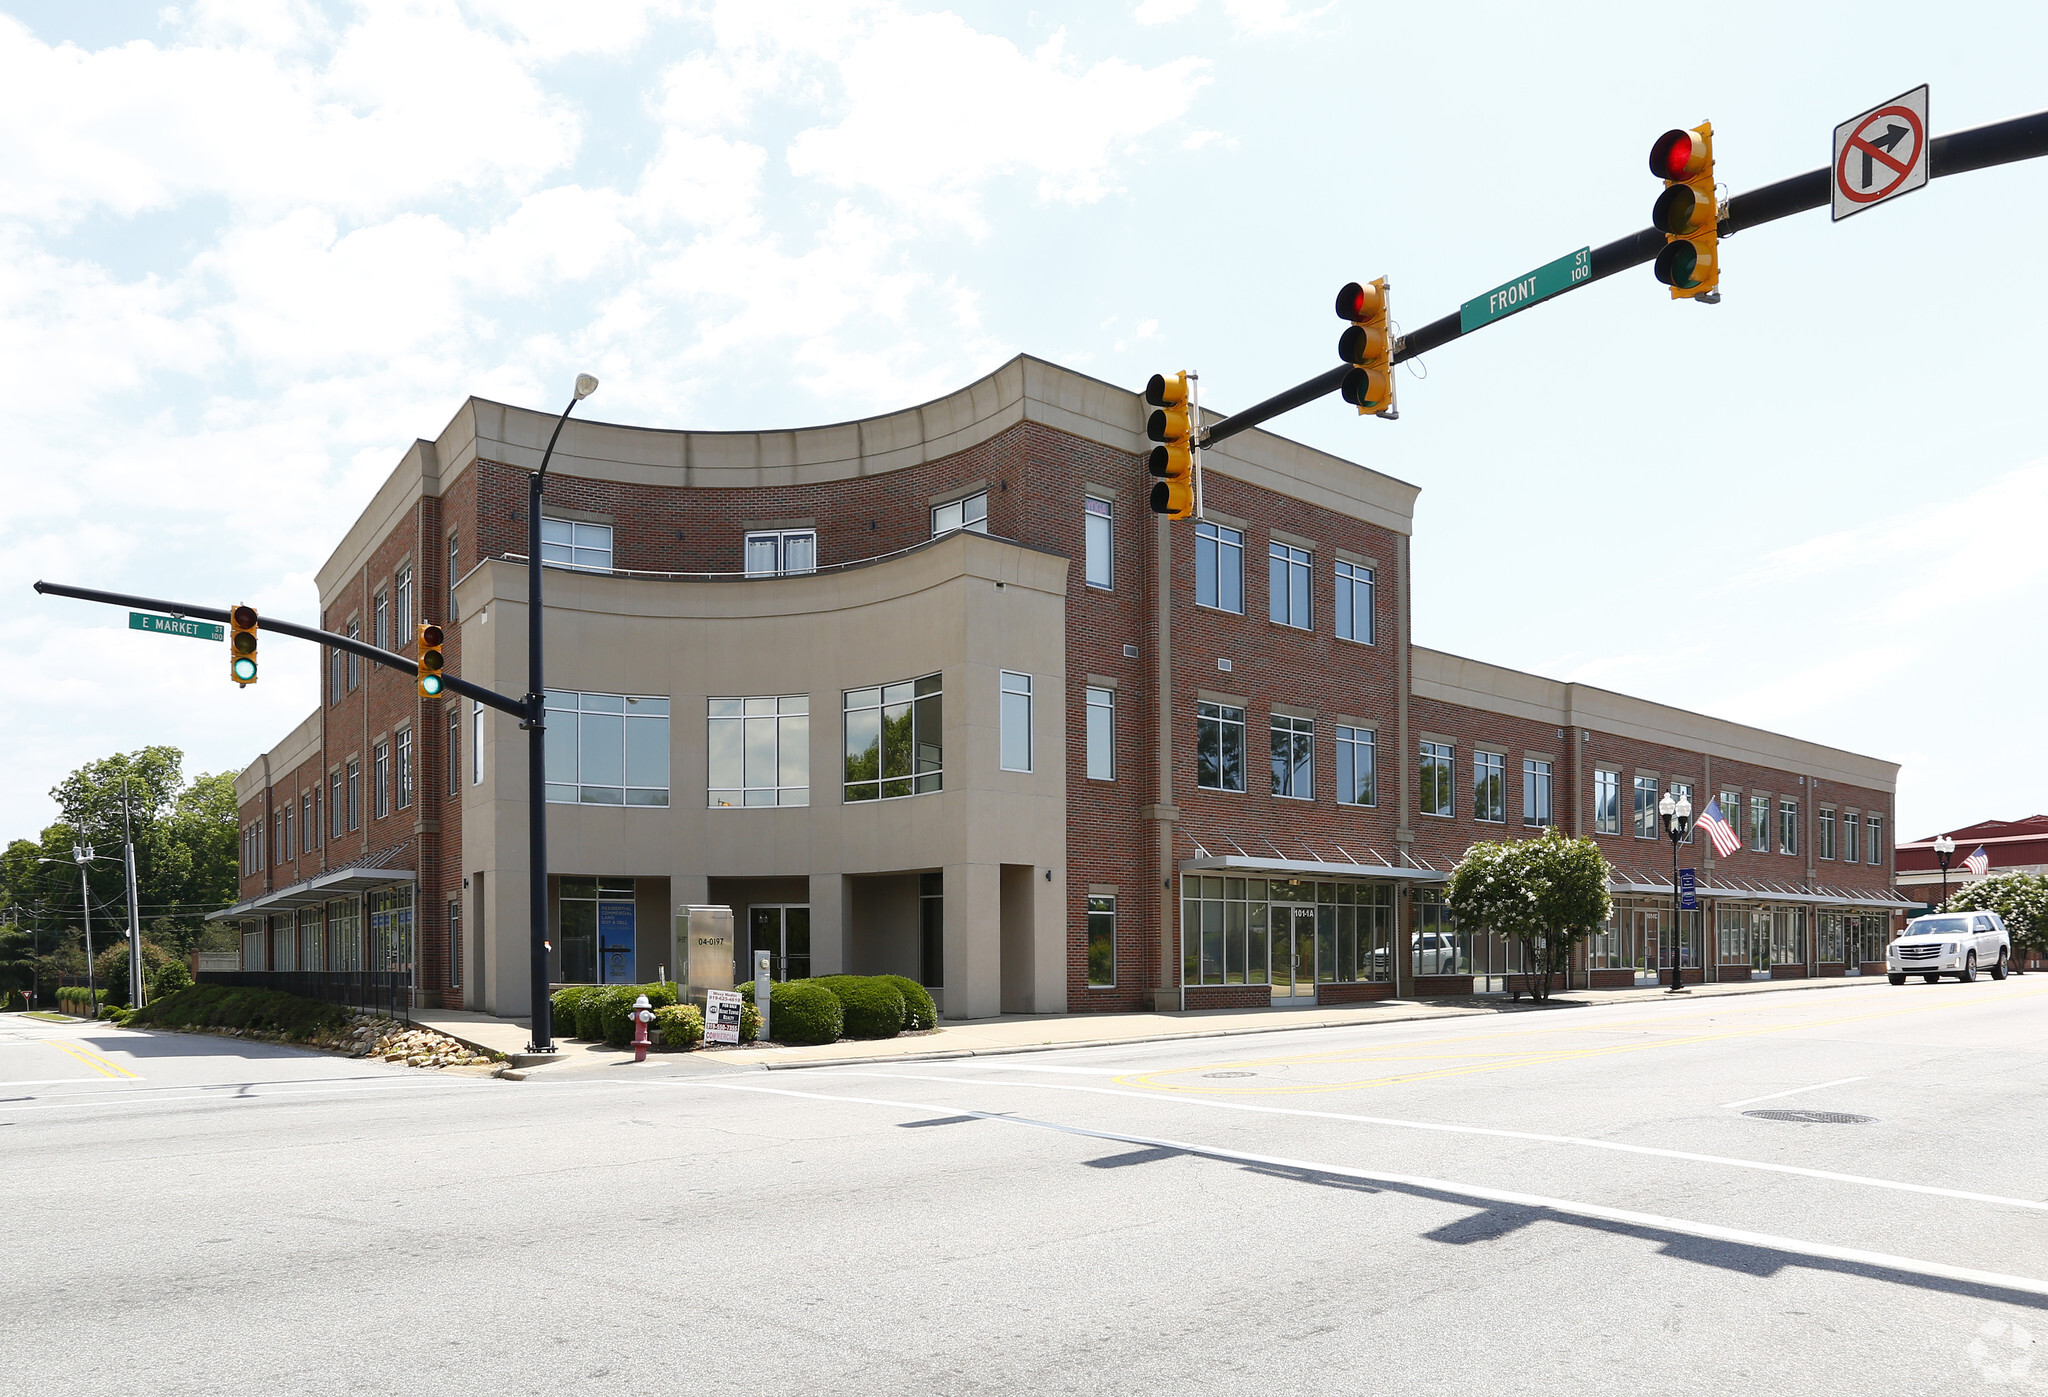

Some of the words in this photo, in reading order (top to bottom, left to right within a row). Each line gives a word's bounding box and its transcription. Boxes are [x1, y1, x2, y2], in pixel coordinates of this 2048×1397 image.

[1489, 276, 1537, 314] FRONT
[1575, 250, 1588, 265] ST
[1571, 265, 1589, 282] 100
[142, 617, 149, 628] E
[155, 619, 199, 635] MARKET
[698, 938, 724, 946] 04-0197
[706, 1031, 737, 1041] COMMERCIAL
